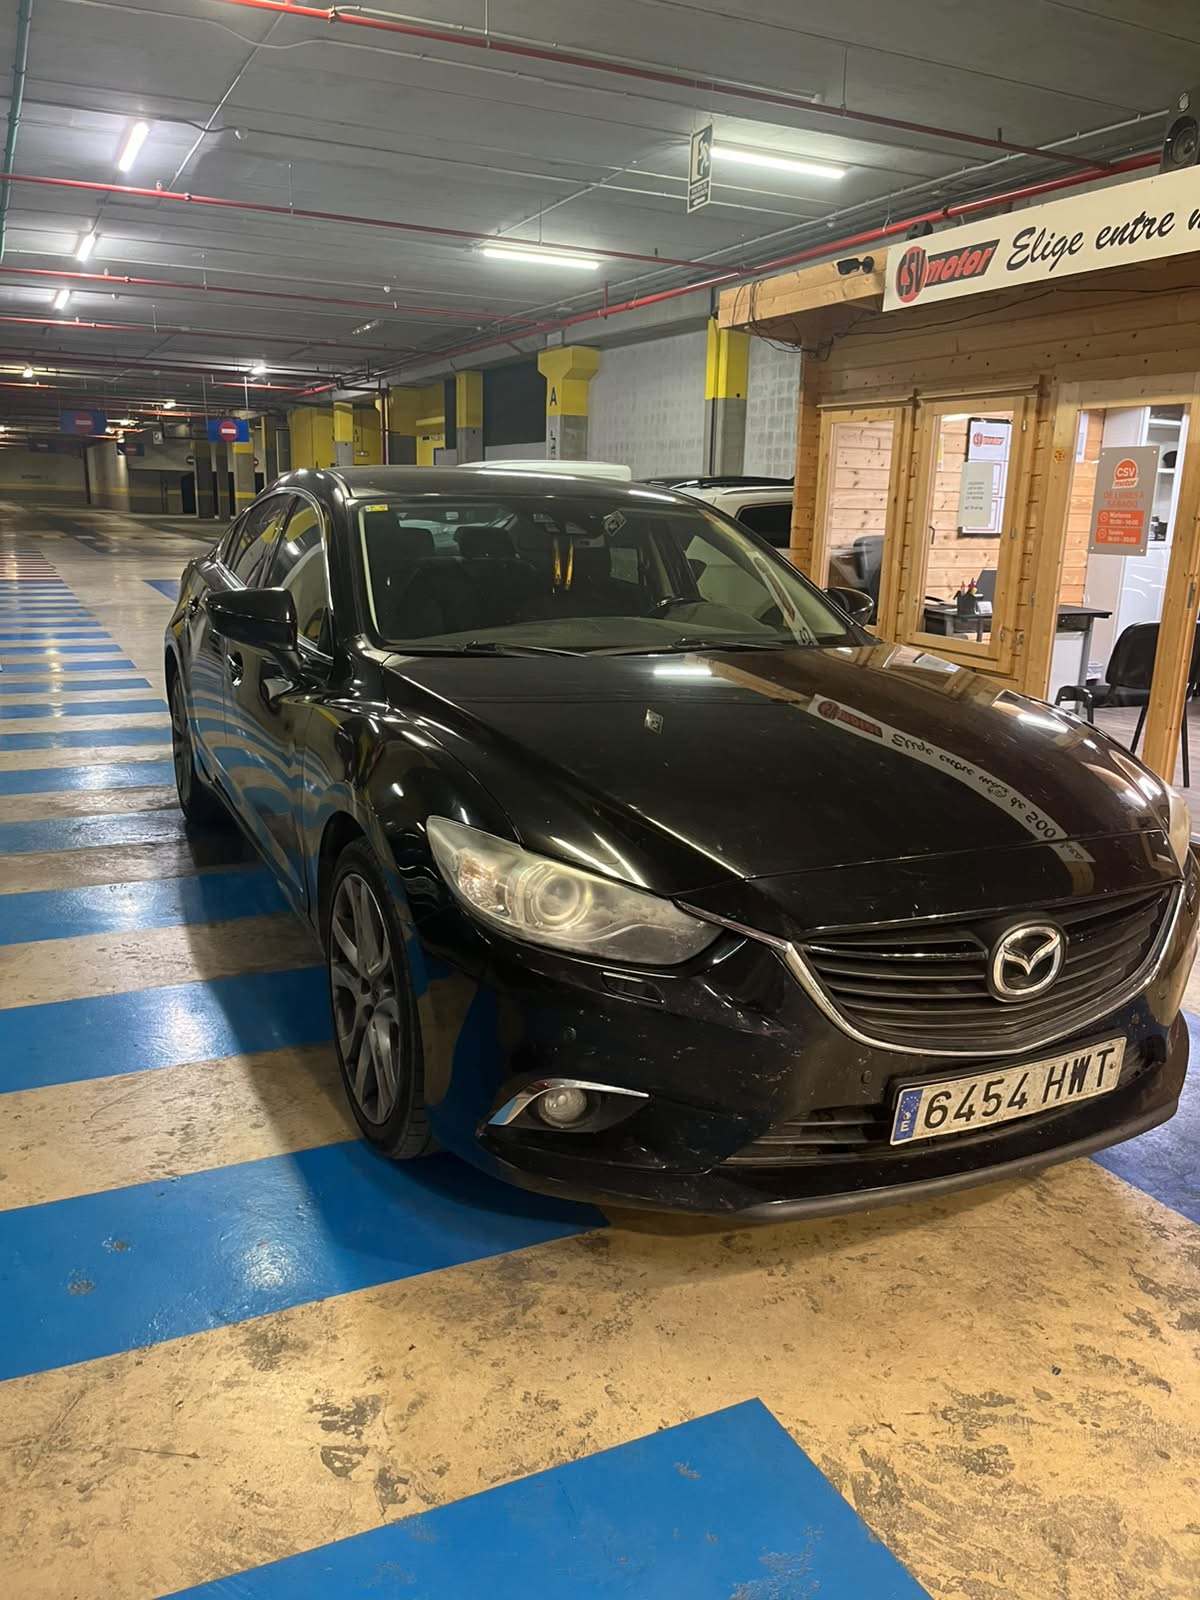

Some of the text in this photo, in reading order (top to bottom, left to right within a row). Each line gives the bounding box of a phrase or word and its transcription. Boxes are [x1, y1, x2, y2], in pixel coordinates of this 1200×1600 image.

[896, 247, 928, 300] CSV
[927, 246, 995, 284] motor
[1005, 226, 1084, 272] Elige
[1095, 210, 1176, 249] entre
[549, 386, 558, 407] A
[1116, 467, 1136, 478] CSV
[923, 1047, 1115, 1129] 6454 HWT
[900, 1121, 910, 1132] E
